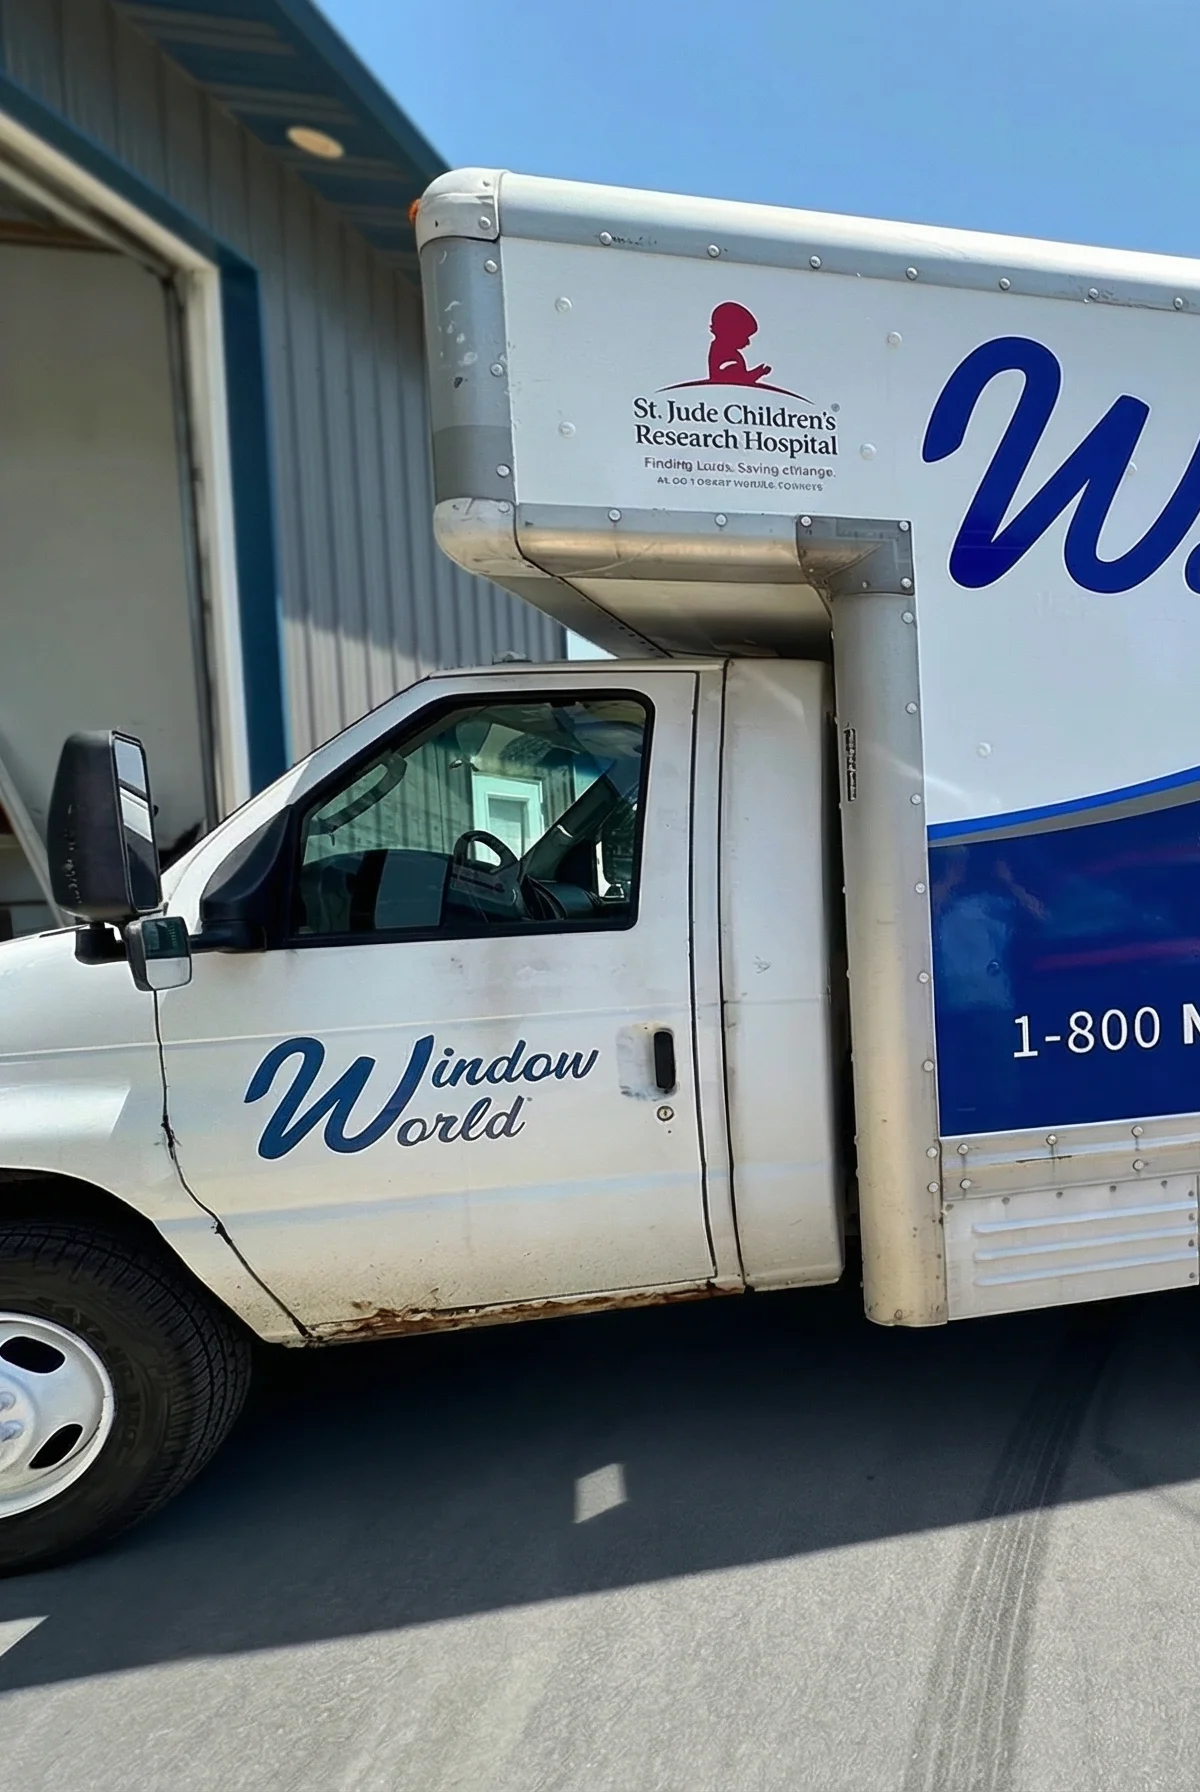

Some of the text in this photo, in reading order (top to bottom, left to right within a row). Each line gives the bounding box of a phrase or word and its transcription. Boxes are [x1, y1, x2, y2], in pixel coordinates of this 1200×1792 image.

[633, 397, 836, 431] St. Jude Children's
[635, 424, 838, 459] Research Hospital
[1013, 1005, 1161, 1058] 1-800
